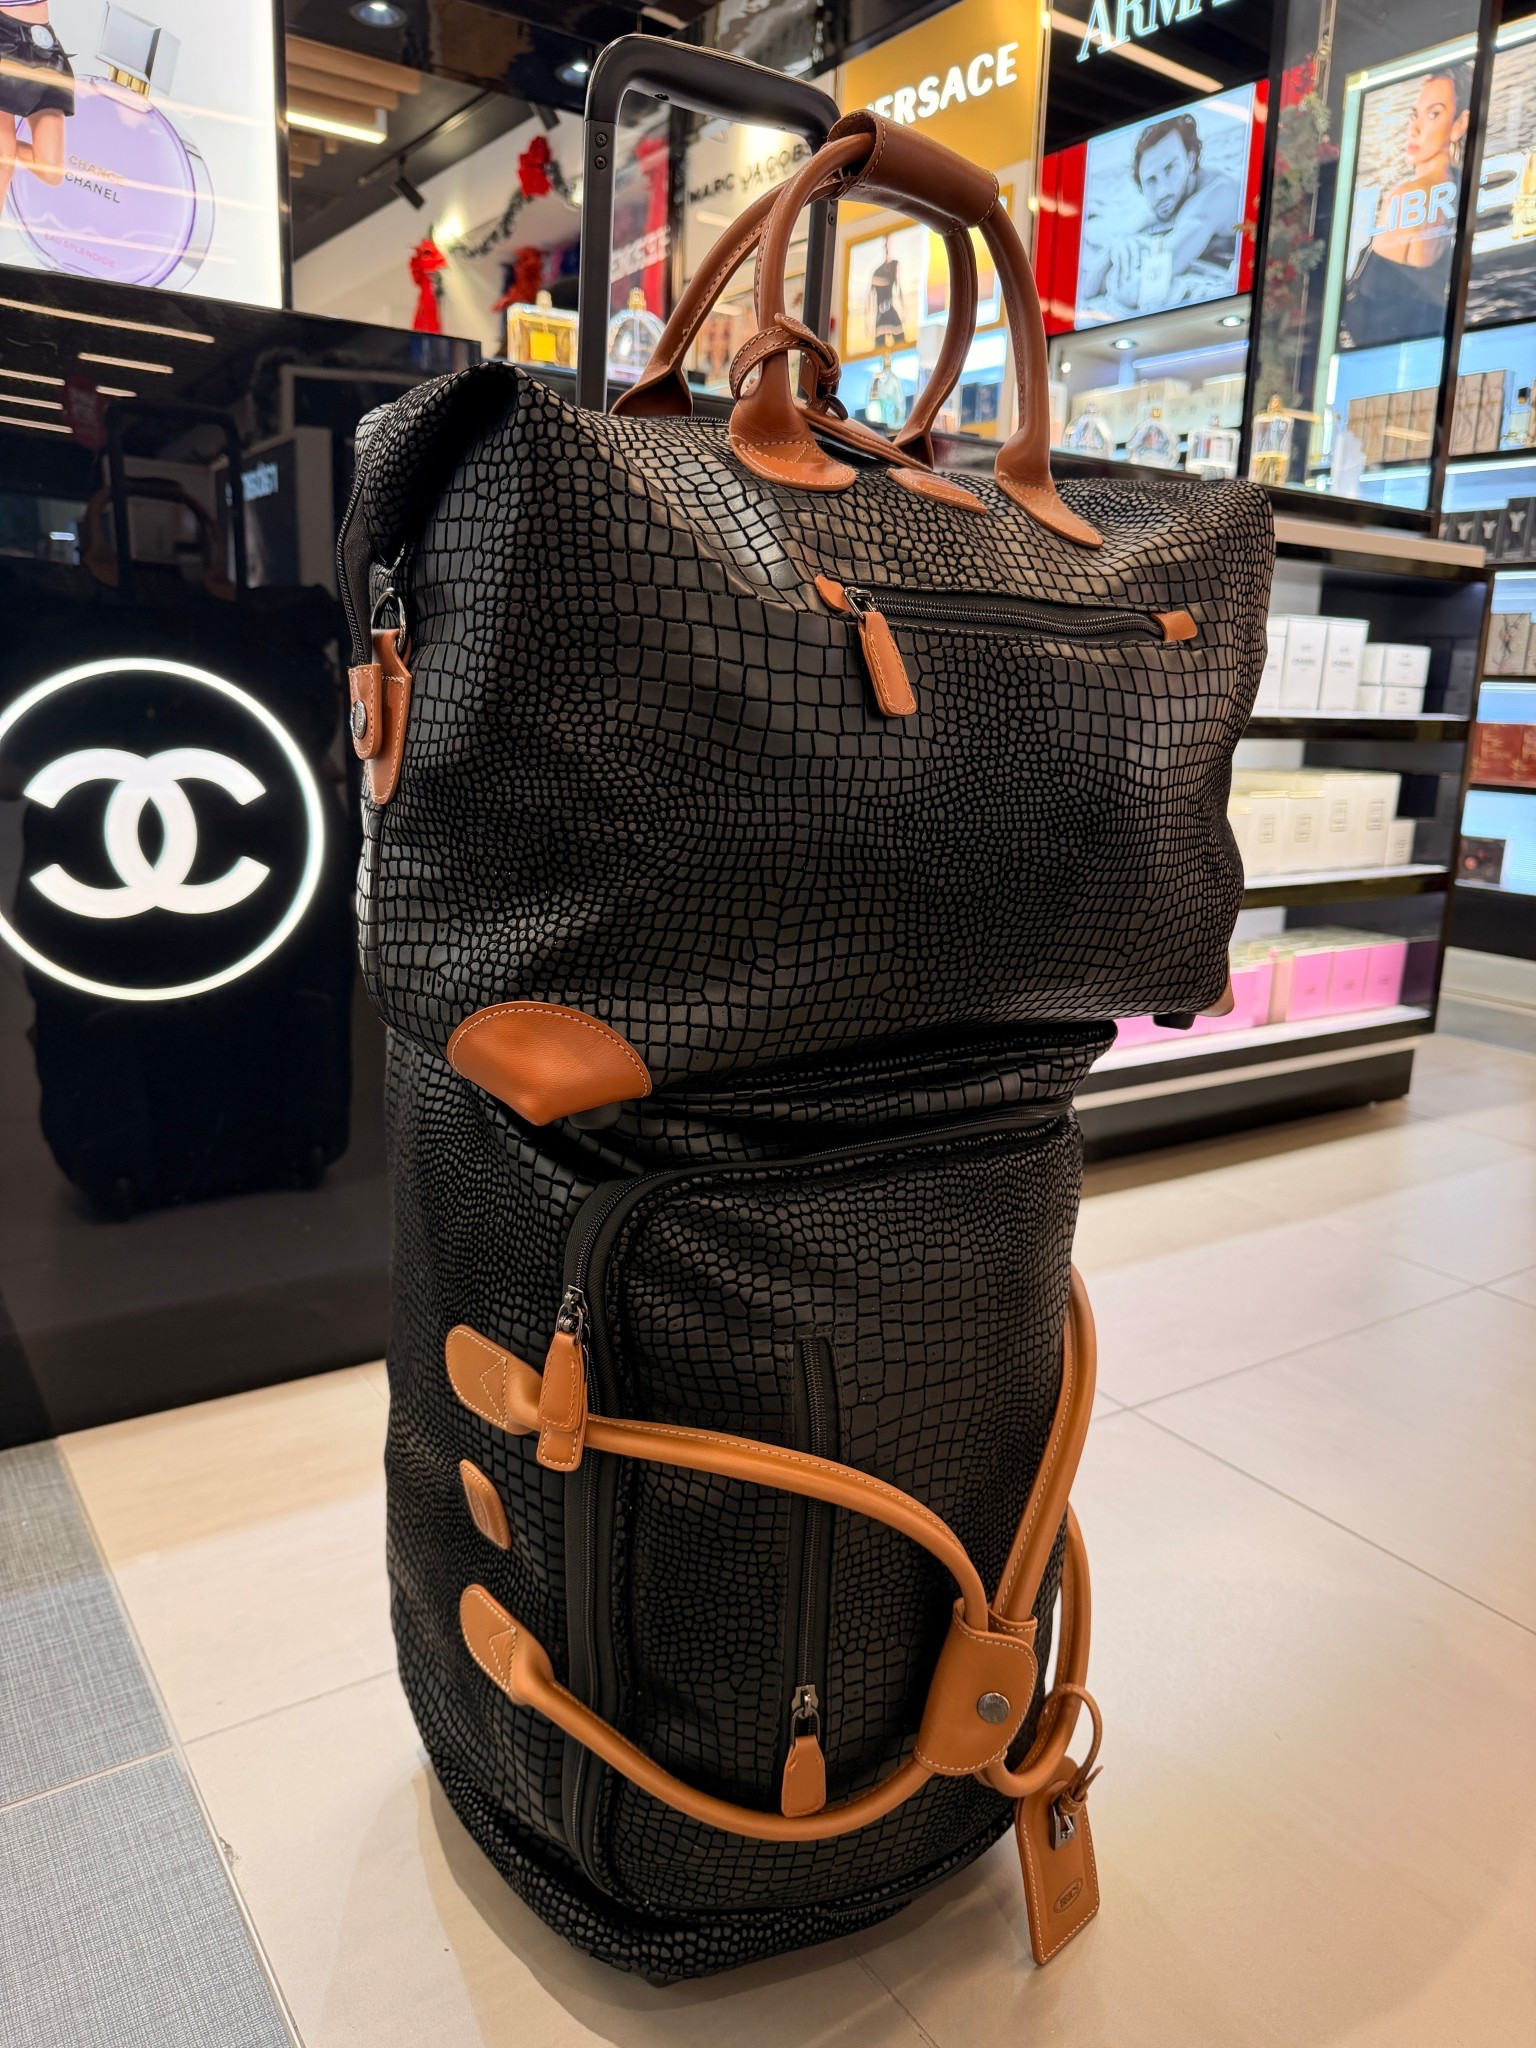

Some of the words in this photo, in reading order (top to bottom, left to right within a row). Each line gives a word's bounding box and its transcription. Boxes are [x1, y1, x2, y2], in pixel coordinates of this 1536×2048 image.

[1076, 0, 1231, 63] AR
[866, 42, 1019, 124] ERSACE
[65, 171, 120, 203] CHANEL
